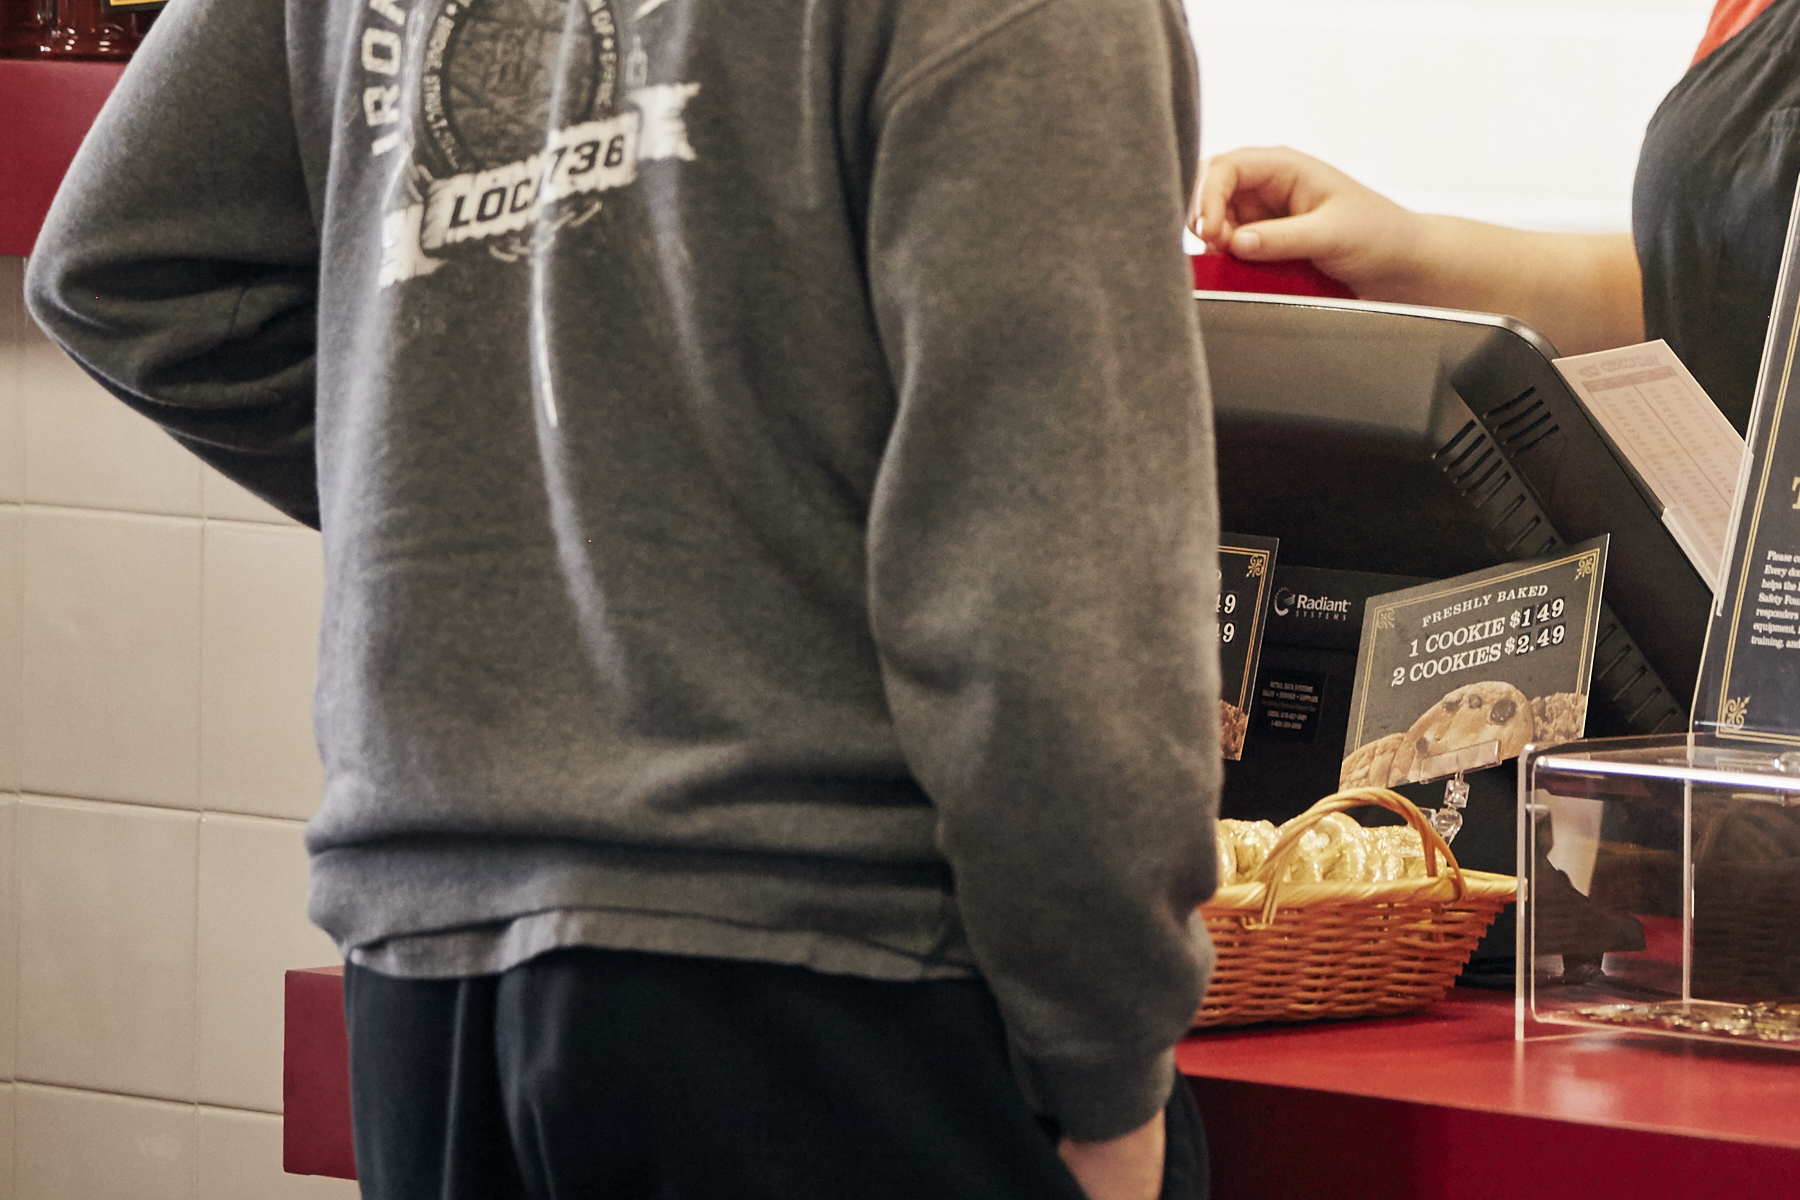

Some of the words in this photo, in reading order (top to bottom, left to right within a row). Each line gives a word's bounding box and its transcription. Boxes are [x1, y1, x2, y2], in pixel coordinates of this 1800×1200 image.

[1767, 550, 1792, 563] Please
[1764, 564, 1788, 578] Every
[1761, 578, 1782, 591] helps
[1783, 581, 1796, 591] the
[1297, 594, 1348, 613] Radiant
[1758, 592, 1783, 606] Safety
[1422, 593, 1493, 628] FRESHLY
[1497, 585, 1549, 603] BAKED
[1295, 610, 1347, 621] SYSTEMS
[1756, 608, 1799, 620] responders
[1409, 639, 1419, 658] 1
[1425, 617, 1506, 654] COOKIE
[1785, 639, 1800, 649] and
[1391, 667, 1406, 687] 2
[1409, 642, 1502, 682] COOKIES
[1504, 624, 1565, 655] $2.49
